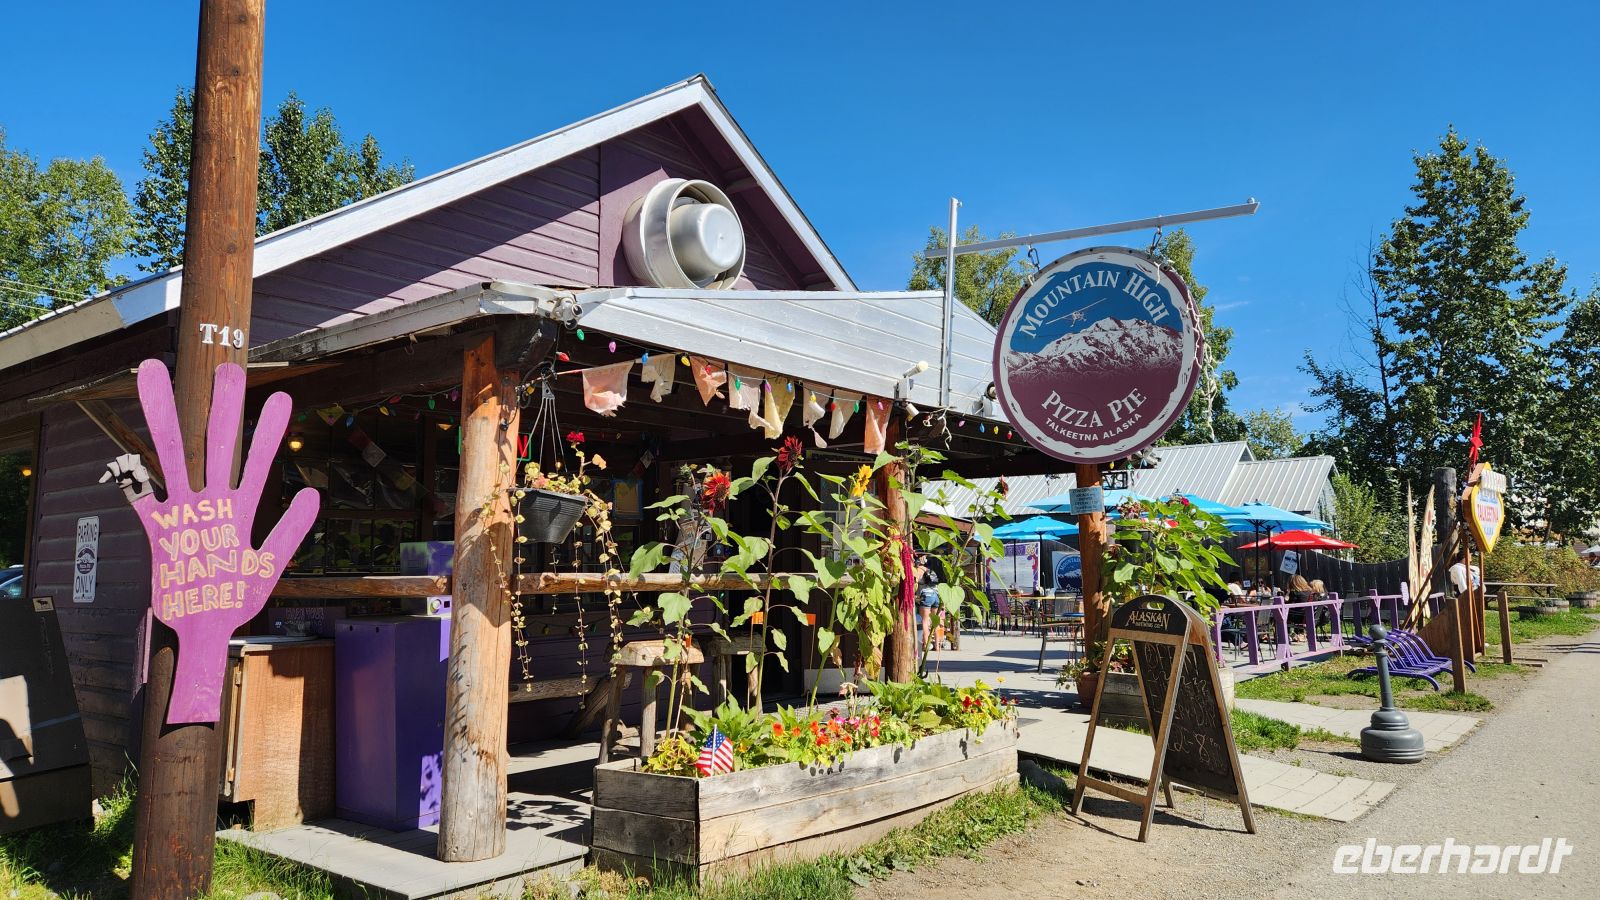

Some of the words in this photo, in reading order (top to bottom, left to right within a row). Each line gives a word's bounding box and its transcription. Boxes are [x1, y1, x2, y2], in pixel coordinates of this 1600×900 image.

[1019, 270, 1121, 339] MOUNTAIN
[1123, 271, 1170, 323] HIGH
[200, 322, 246, 349] T19
[1041, 390, 1104, 428] PIZZA
[1106, 387, 1148, 423] PIE
[1045, 417, 1099, 441] TALKEETNA
[1103, 413, 1143, 439] ALASKA
[151, 498, 234, 530] WASH
[77, 522, 98, 543] PARKING
[158, 523, 240, 562] YOUR
[160, 549, 277, 589] HANDS
[1060, 557, 1081, 571] MOUNTAI
[75, 575, 94, 594] ONLY
[162, 582, 246, 621] HERE!
[1125, 610, 1172, 631] ALASKAN
